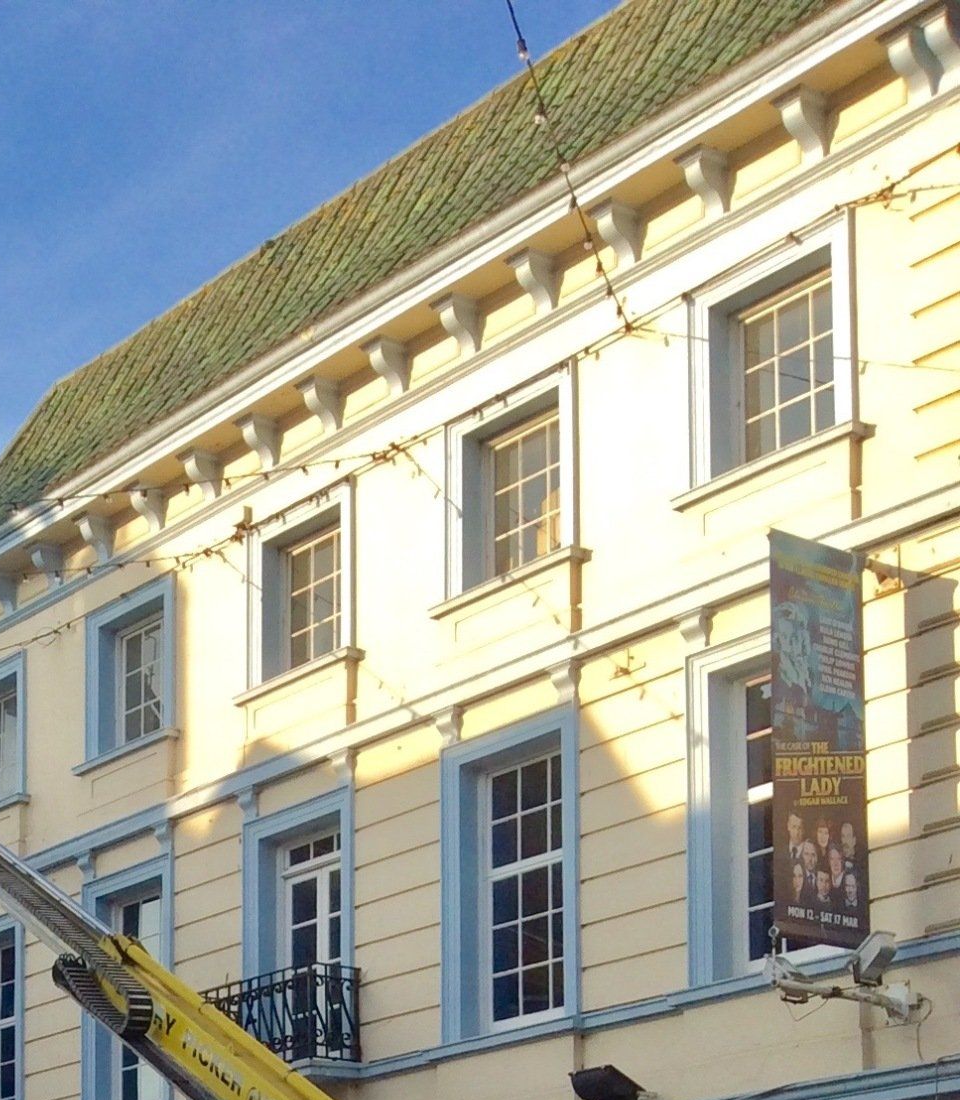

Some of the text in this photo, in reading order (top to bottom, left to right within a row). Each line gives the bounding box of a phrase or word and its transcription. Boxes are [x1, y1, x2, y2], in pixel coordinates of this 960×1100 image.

[811, 741, 829, 754] THE
[775, 756, 865, 776] FRIGHTENED
[800, 777, 841, 797] LADY
[788, 905, 805, 918] MON
[806, 909, 814, 920] 12
[820, 911, 833, 923] SAT
[842, 915, 858, 928] MAR
